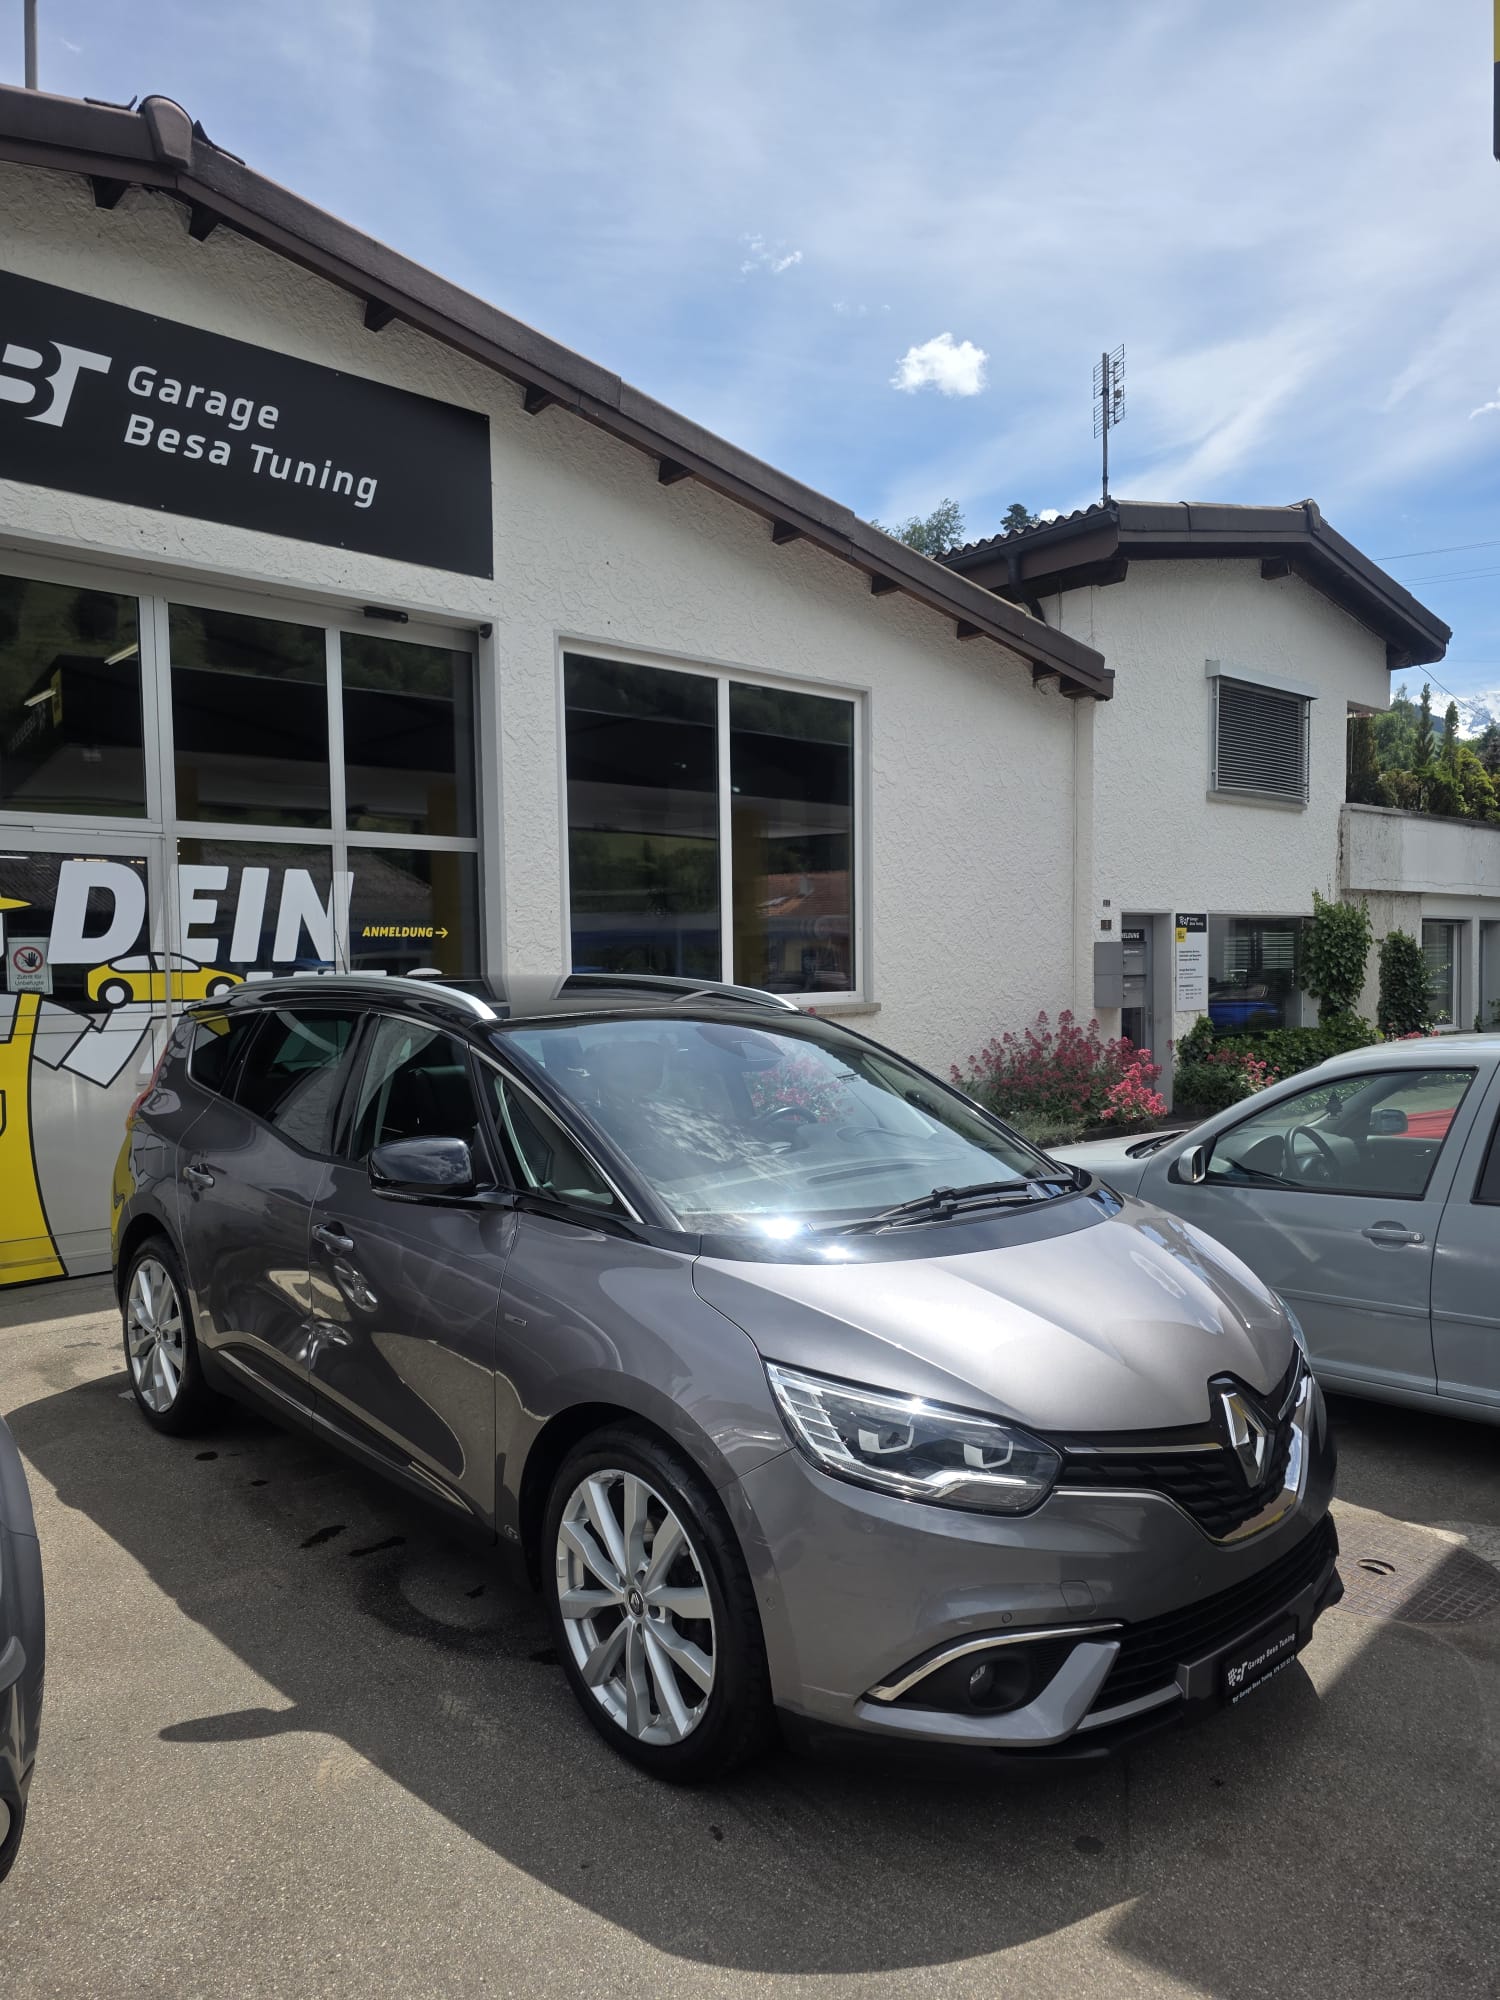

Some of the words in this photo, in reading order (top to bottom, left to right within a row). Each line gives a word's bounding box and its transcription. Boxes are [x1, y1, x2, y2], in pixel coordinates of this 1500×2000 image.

[127, 365, 280, 432] Garage
[124, 414, 231, 466] Besa
[250, 444, 378, 509] Tuning
[47, 860, 355, 965] DEIN
[362, 926, 434, 938] ANMELDUNG
